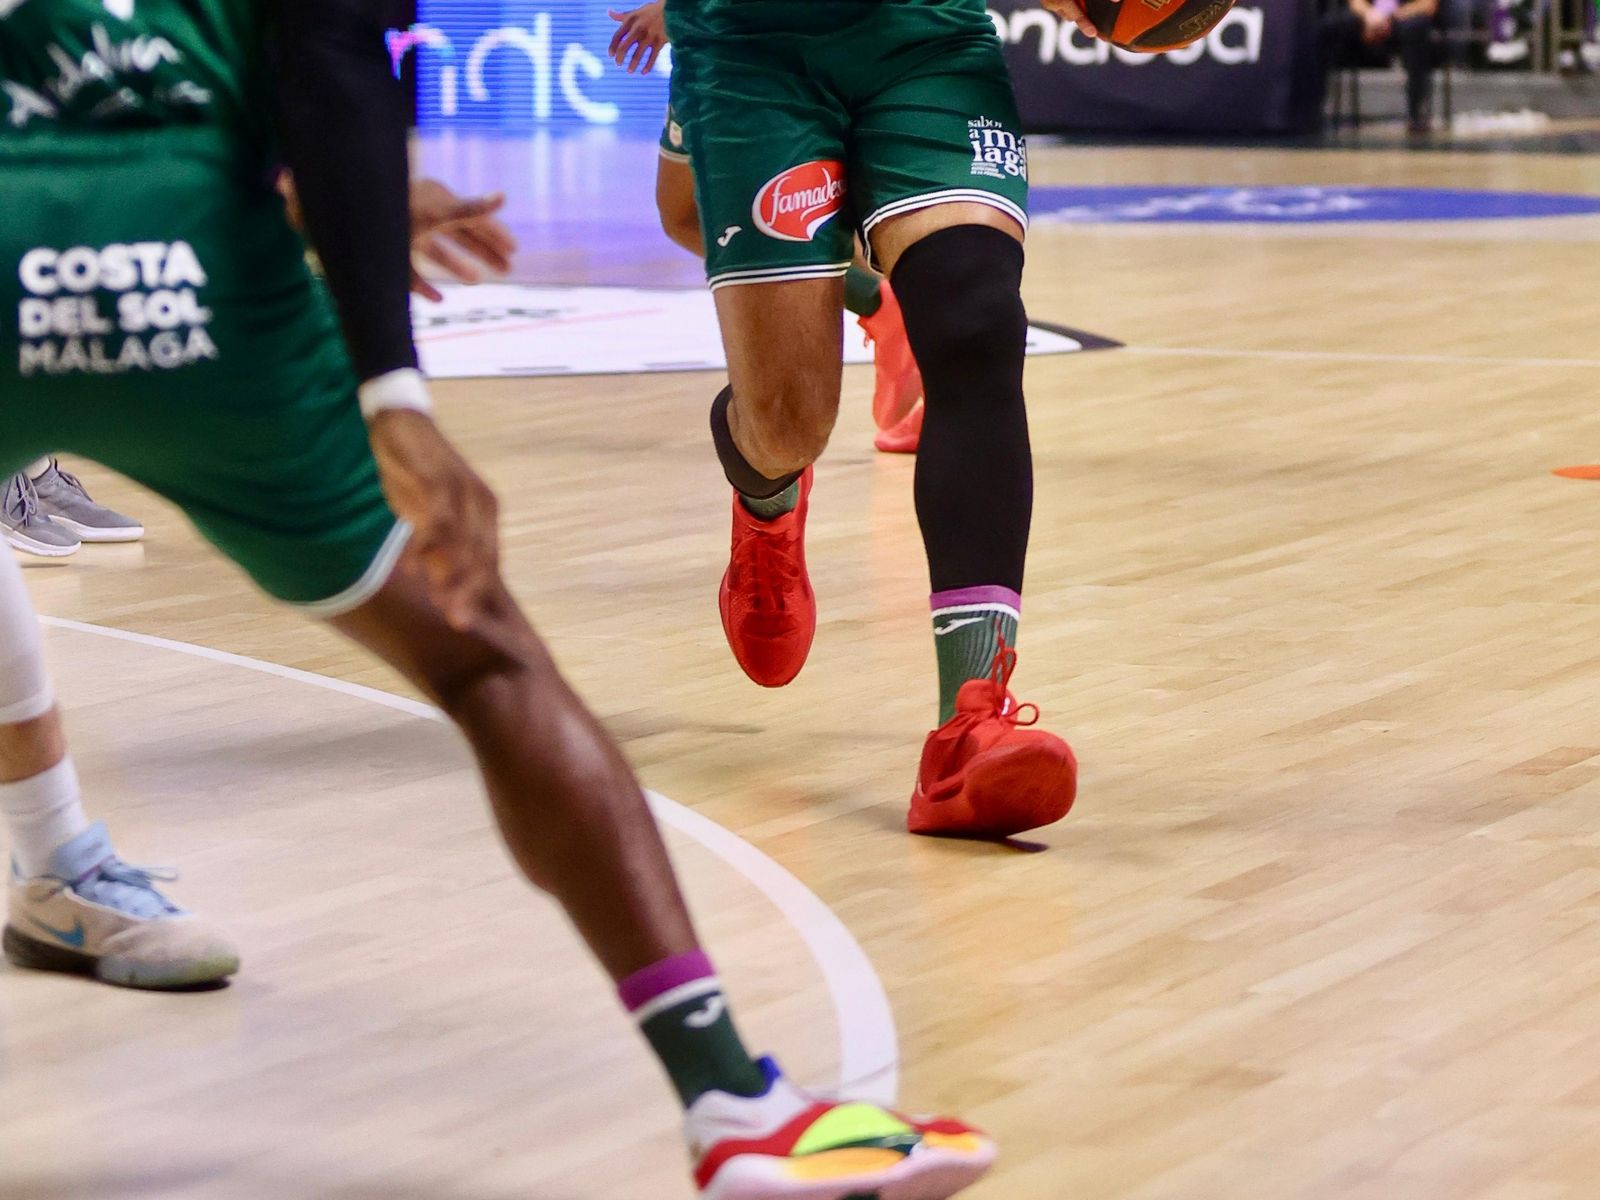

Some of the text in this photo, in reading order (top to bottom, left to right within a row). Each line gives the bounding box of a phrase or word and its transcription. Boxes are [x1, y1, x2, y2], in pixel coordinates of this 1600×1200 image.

[18, 240, 208, 296] COSTA
[18, 287, 213, 340] DEL SOL
